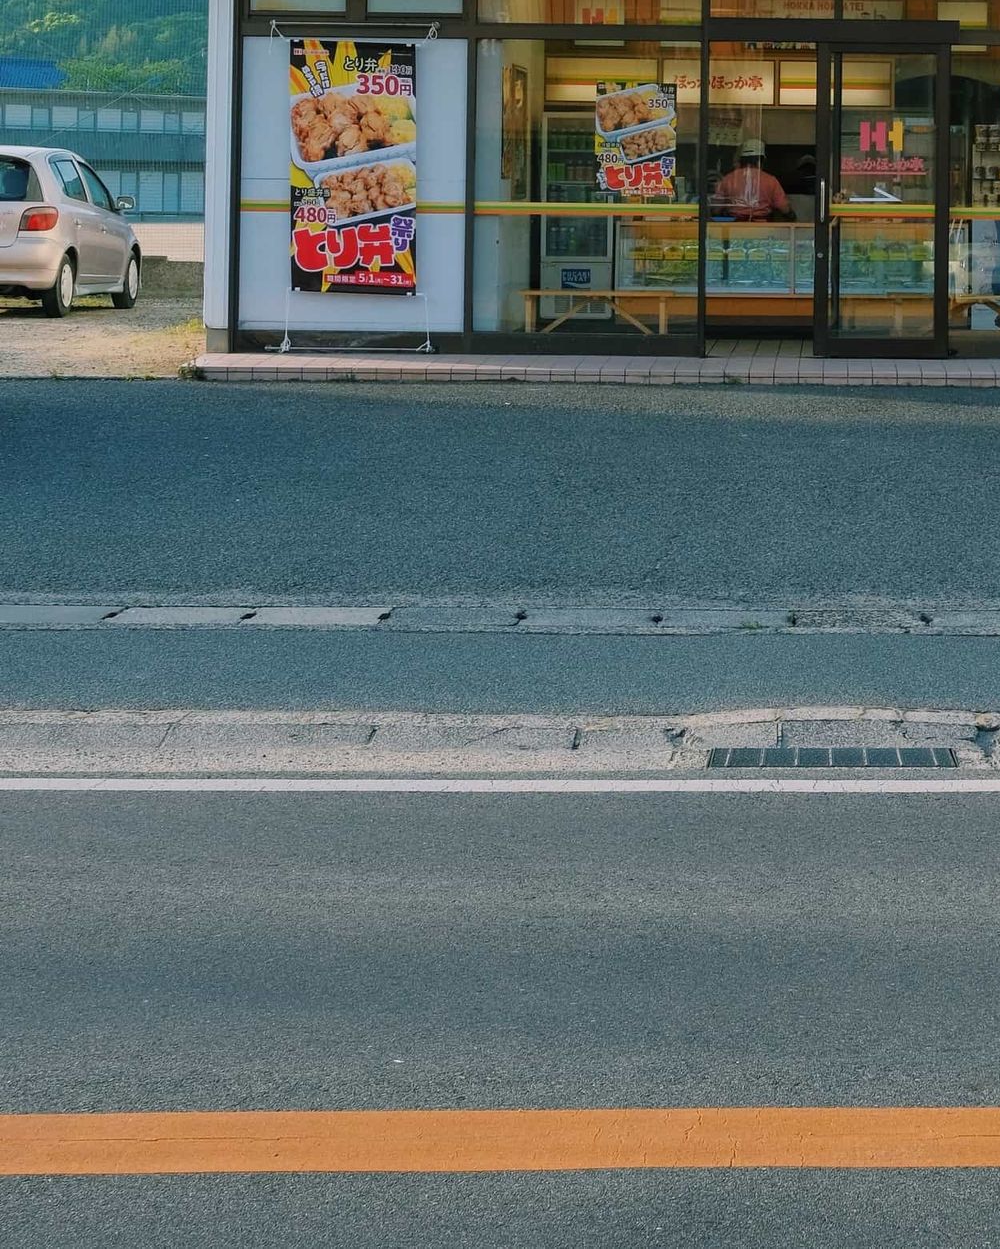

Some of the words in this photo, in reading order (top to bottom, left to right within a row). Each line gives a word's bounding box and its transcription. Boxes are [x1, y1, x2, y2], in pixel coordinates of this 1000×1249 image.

[344, 57, 377, 71] とり弁
[356, 74, 412, 96] 350円
[294, 207, 336, 224] 480円
[391, 216, 414, 251] 祭り
[294, 225, 394, 270] とり弁
